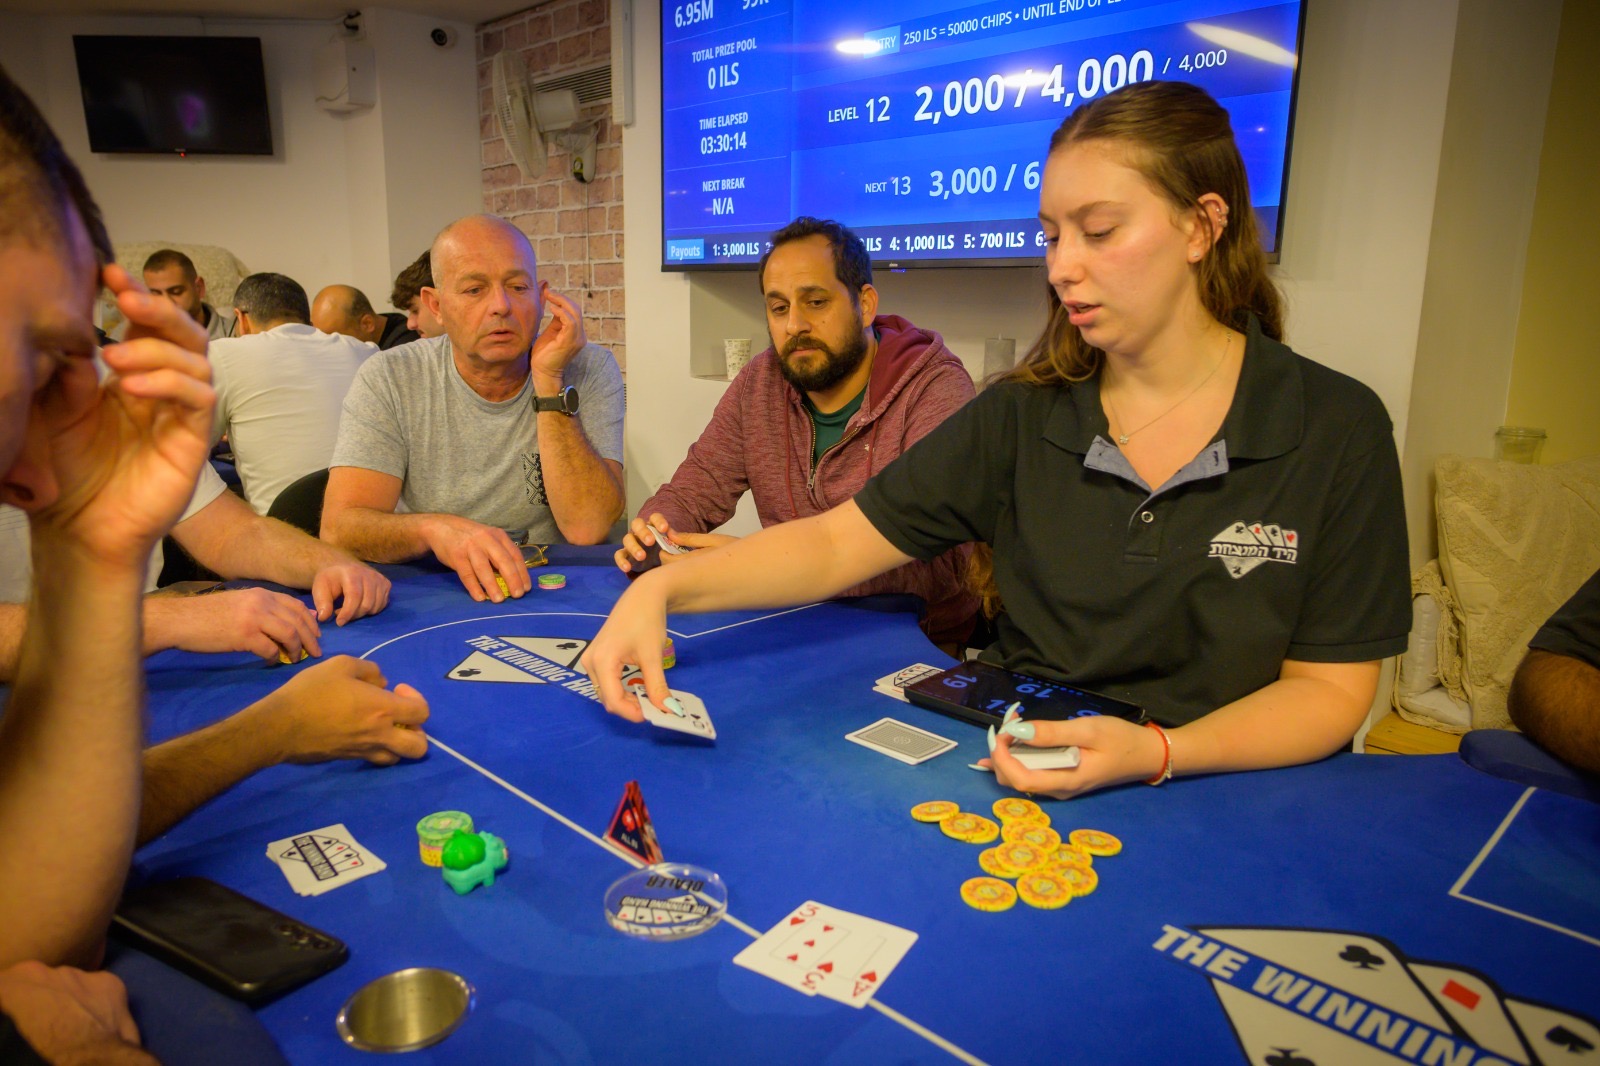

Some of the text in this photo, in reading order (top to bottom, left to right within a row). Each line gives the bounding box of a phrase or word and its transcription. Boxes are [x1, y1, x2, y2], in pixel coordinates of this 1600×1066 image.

[674, 0, 714, 28] 6.95M
[903, 30, 921, 46] 250
[923, 27, 938, 42] ILS
[947, 18, 979, 37] 50000
[980, 11, 1012, 30] CHIPS
[1022, 3, 1057, 21] UNTIL
[1059, 0, 1084, 14] END
[692, 37, 757, 63] TOTAL PRIZE POOL
[707, 61, 740, 90] 0 ILS
[913, 73, 1005, 125] 2,000
[1040, 49, 1154, 108] 4,000
[1178, 49, 1227, 73] 4,000
[699, 111, 749, 130] TIME ELAPSED
[828, 95, 891, 123] LEVEL 12
[700, 131, 748, 155] 03:30:14
[702, 177, 745, 192] NEXT BREAK
[865, 175, 911, 196] NEXT 13
[929, 165, 997, 200] 3,000
[712, 197, 735, 216] N/A
[670, 245, 701, 261] Payouts
[712, 244, 721, 257] 1:
[722, 243, 745, 258] 3,000
[746, 242, 760, 256] ILS
[866, 237, 882, 252] ILS
[889, 236, 901, 251] 4:
[904, 235, 935, 253] 1,000
[936, 234, 955, 250] ILS
[963, 233, 976, 249] 5:
[979, 232, 1003, 248] 700
[1005, 231, 1025, 248] ILS
[1208, 543, 1298, 561] היד המנצחת
[465, 635, 508, 652] THE
[492, 648, 576, 682] WINNING
[646, 875, 705, 892] DEALER
[1152, 924, 1516, 1066] THE WINNIN
